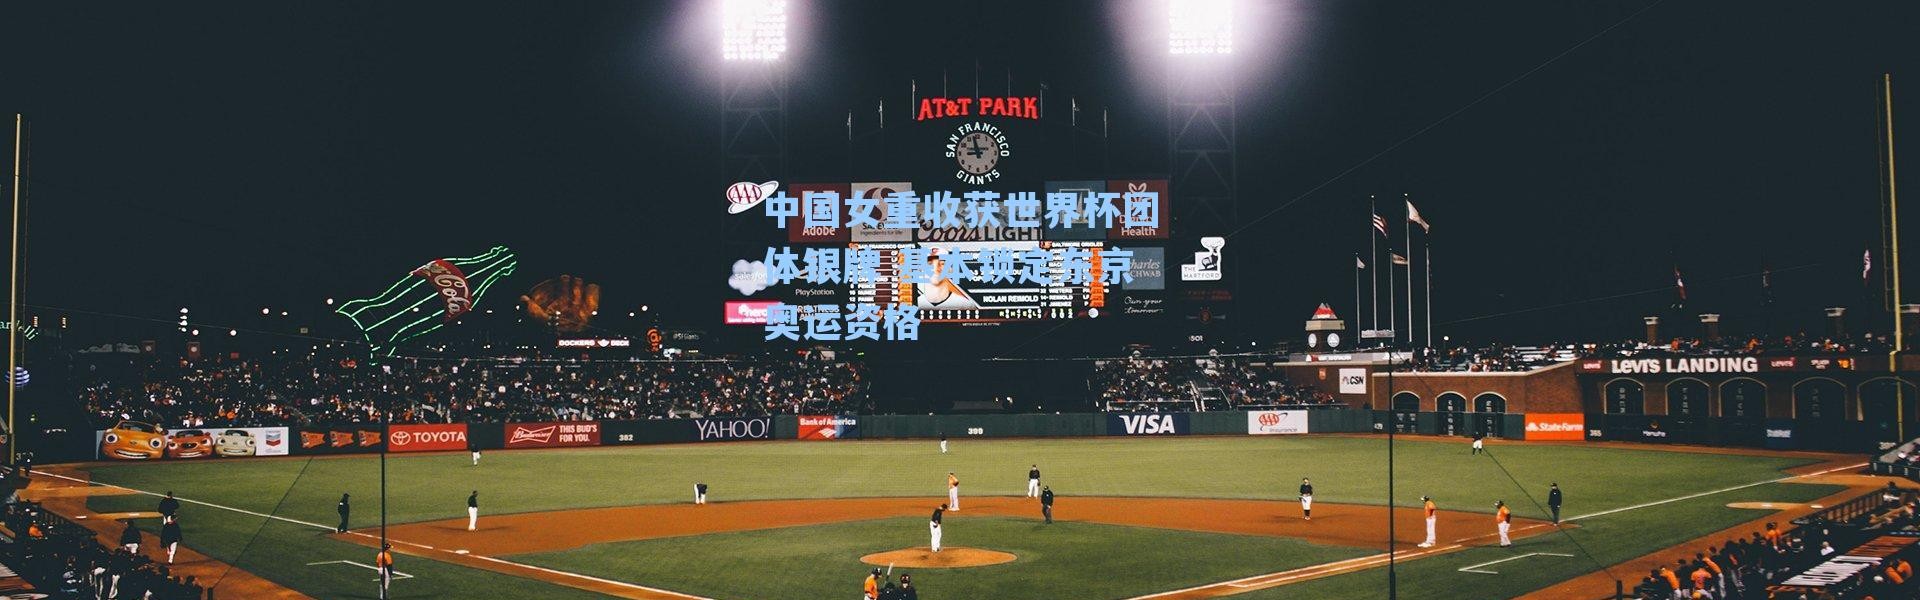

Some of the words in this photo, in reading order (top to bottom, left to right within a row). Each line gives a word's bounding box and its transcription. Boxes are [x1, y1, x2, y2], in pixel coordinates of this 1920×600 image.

[918, 97, 972, 121] AT&T
[979, 97, 1038, 120] PARK
[946, 134, 960, 158] SAN
[958, 122, 1010, 157] FRANCISCO
[956, 169, 1001, 186] GIANTS
[803, 227, 836, 236] Adobe
[1121, 227, 1155, 236] Health
[1130, 259, 1161, 269] harles
[795, 288, 835, 297] PlayStation
[983, 295, 1007, 303] NOLAN
[1008, 295, 1039, 303] REIMOLD
[610, 339, 630, 347] DECK
[1665, 357, 1758, 373] LANDING
[1349, 377, 1364, 385] CSN
[799, 418, 818, 426] Bank
[819, 418, 827, 426] of
[827, 418, 857, 426] America
[1119, 415, 1175, 435] VISA
[559, 425, 575, 433] THIS
[576, 424, 598, 432] BUD'S
[695, 418, 770, 441] YAHOO!
[413, 431, 467, 443] TOYOTA
[514, 430, 552, 439] Budweiser
[559, 434, 573, 442] FOR
[574, 434, 591, 442] YOU.
